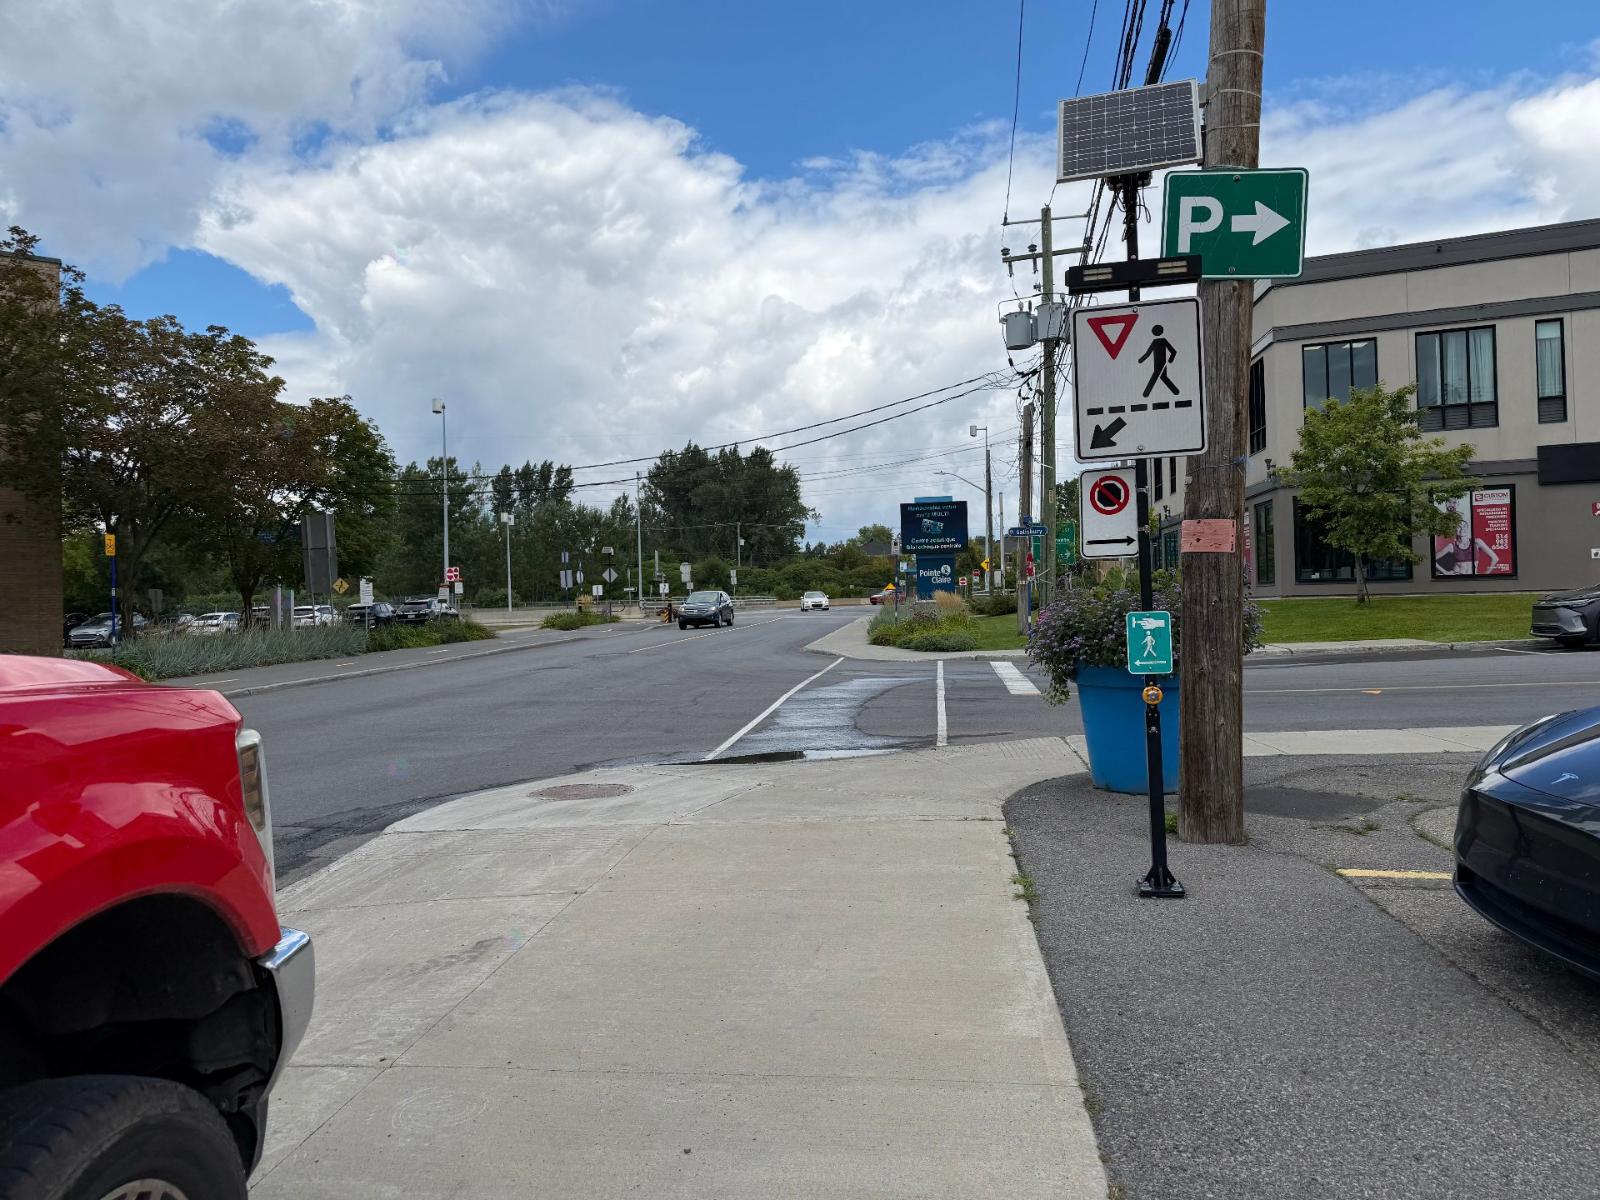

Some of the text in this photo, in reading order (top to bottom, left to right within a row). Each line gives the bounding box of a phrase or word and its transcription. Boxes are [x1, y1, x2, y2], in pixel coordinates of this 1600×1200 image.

[1177, 196, 1224, 253] P
[919, 569, 941, 577] Pointe
[931, 576, 952, 584] Claire
